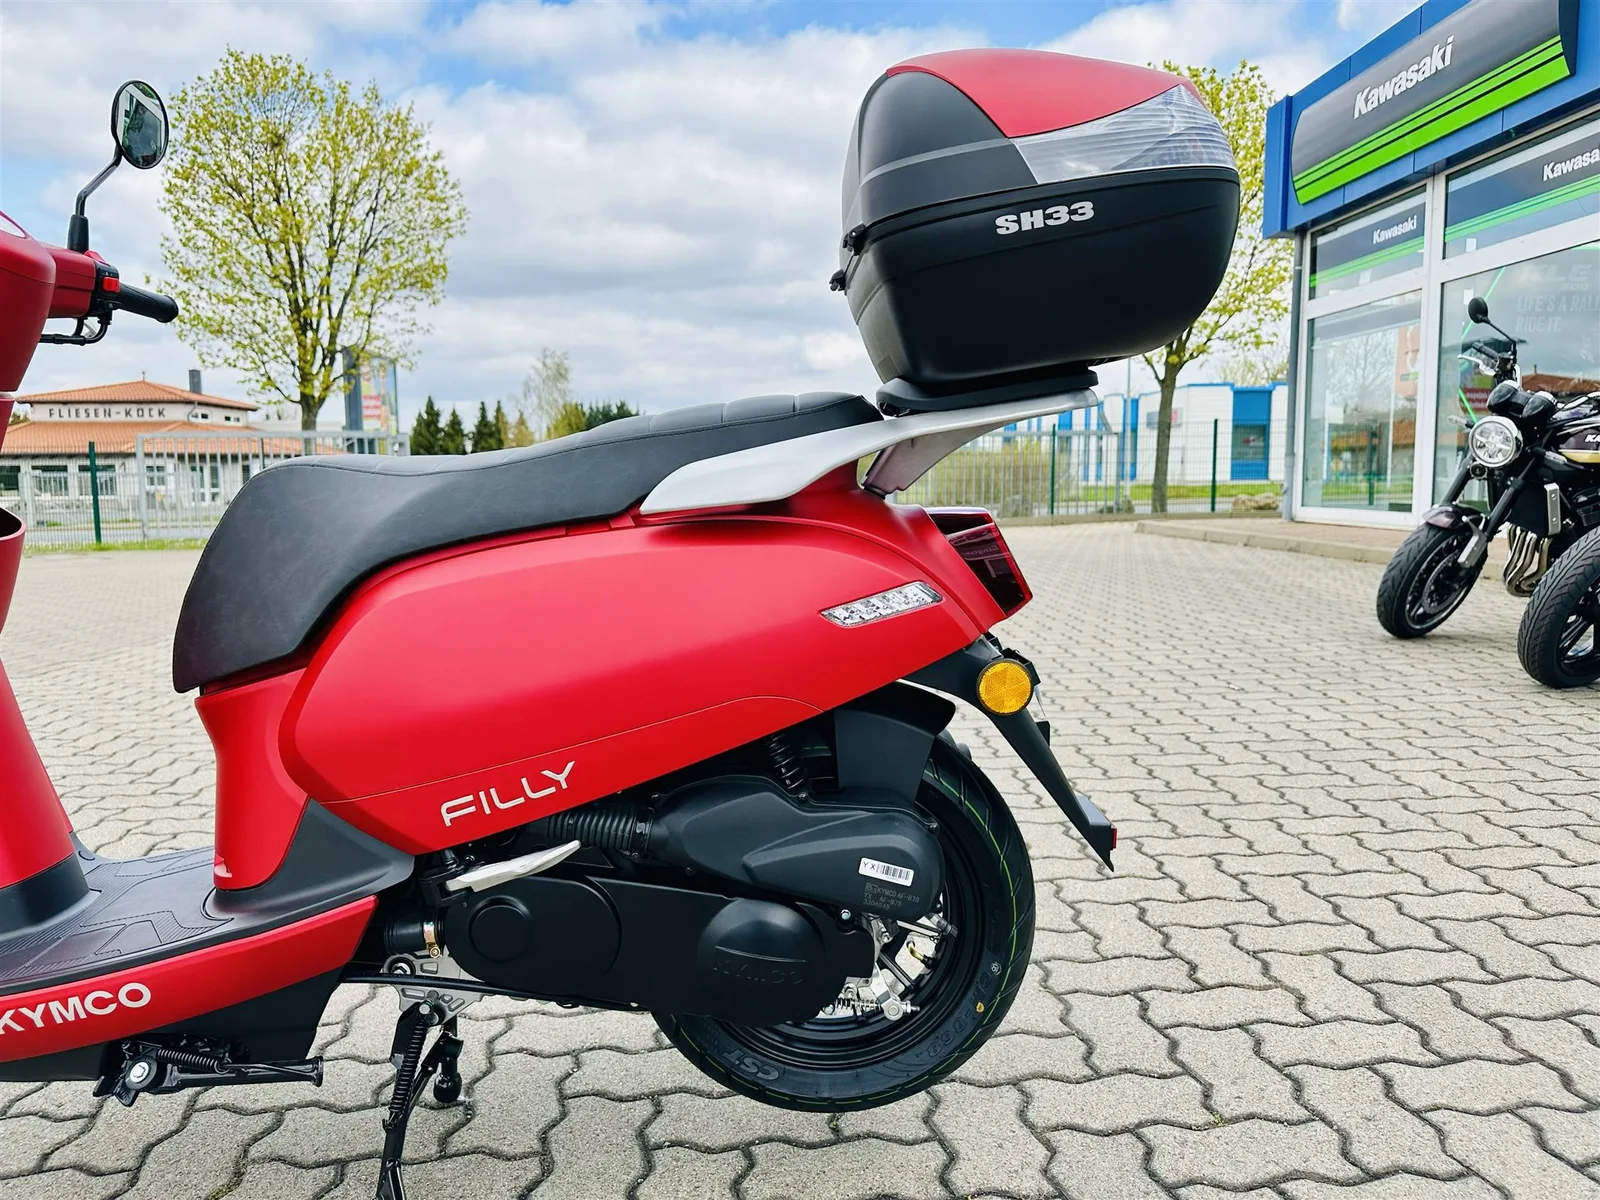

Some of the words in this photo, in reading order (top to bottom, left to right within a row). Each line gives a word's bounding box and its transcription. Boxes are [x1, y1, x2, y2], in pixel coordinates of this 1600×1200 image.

[1353, 35, 1455, 119] Kawasaki
[995, 201, 1095, 235] SH33
[1373, 215, 1417, 244] Kawasaki
[1515, 294, 1556, 312] LIFE'S
[1558, 296, 1567, 312] A
[48, 408, 166, 418] FLIESEN-KOCK
[440, 760, 576, 827] FILLY
[0, 983, 151, 1035] KYMCO
[722, 1049, 779, 1080] CST
